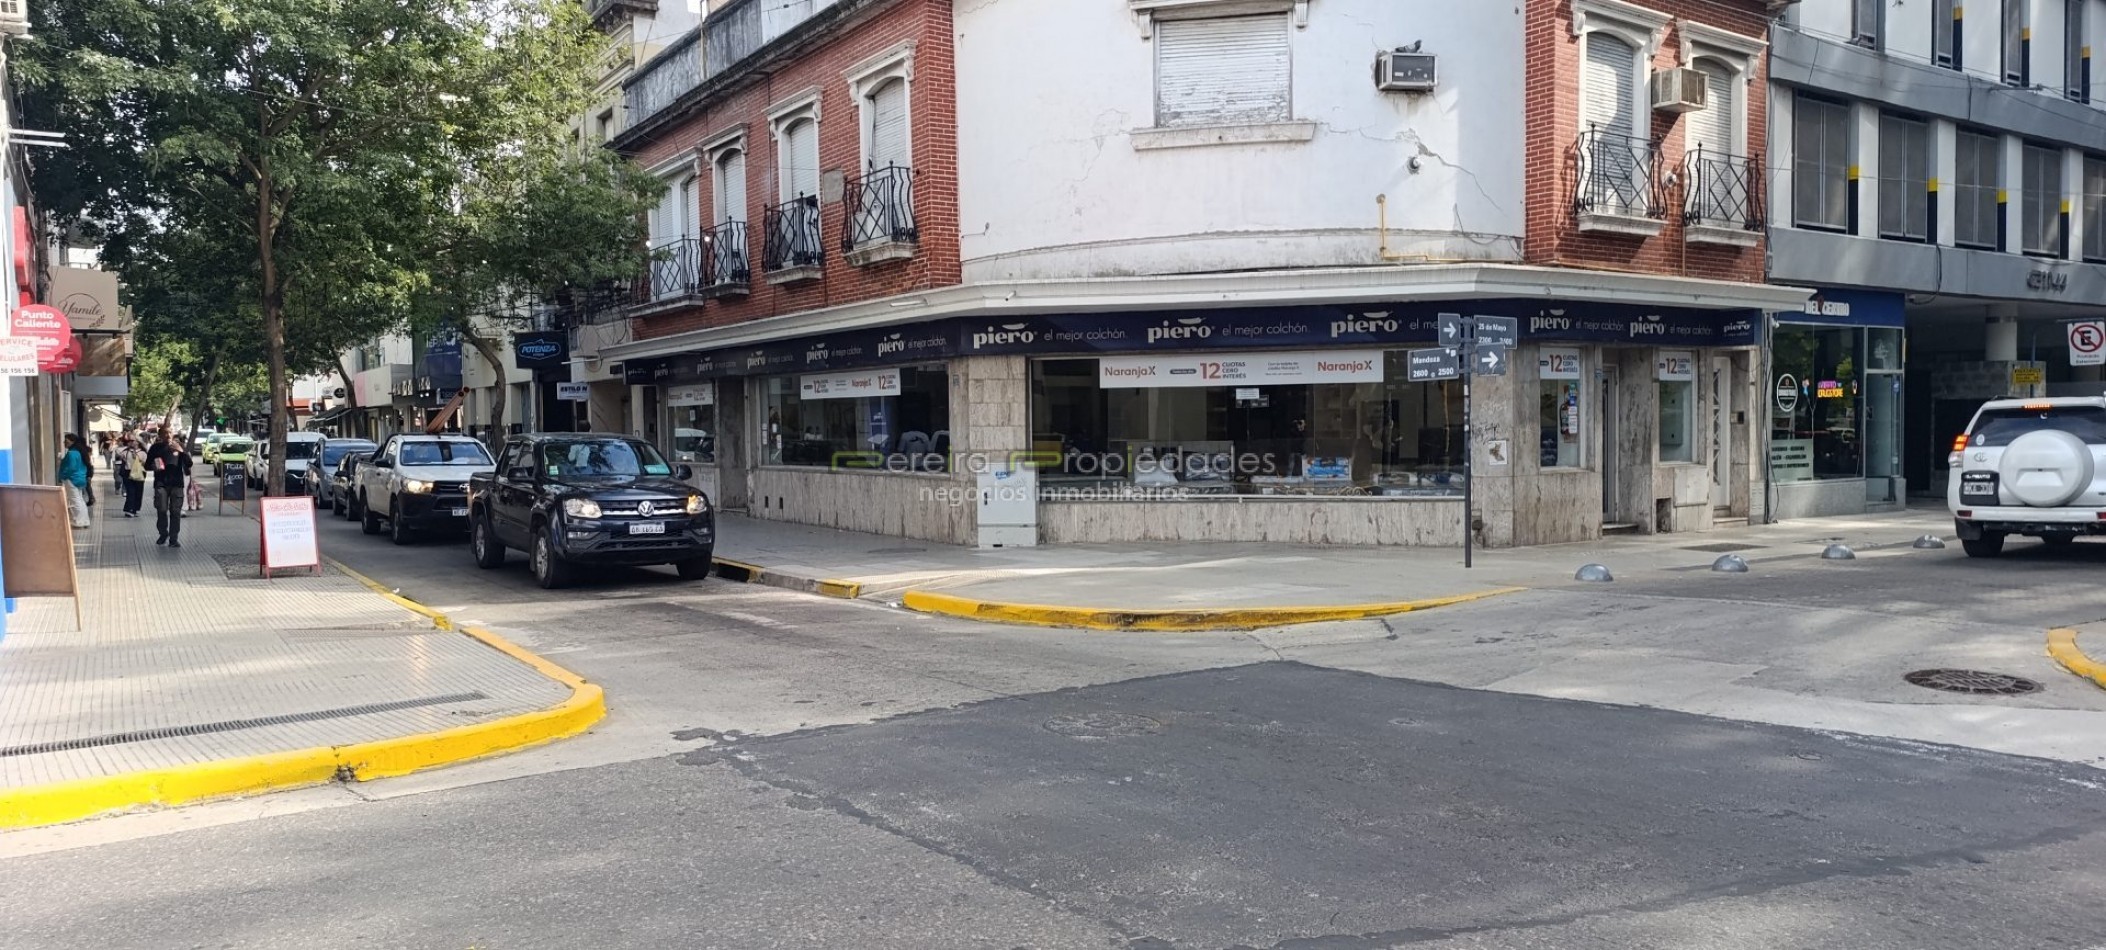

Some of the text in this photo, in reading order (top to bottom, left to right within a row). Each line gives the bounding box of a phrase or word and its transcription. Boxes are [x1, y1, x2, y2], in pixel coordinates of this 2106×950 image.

[22, 310, 54, 319] Punto
[1530, 310, 1570, 333] piero
[14, 319, 61, 328] Caliente
[1148, 320, 1212, 343] piero
[1222, 325, 1231, 336] el
[1331, 314, 1398, 338] piero
[1409, 318, 1419, 329] el
[1493, 323, 1507, 332] Mayo
[1630, 316, 1665, 338] piero
[1724, 322, 1750, 333] piero
[973, 326, 1034, 349] piero
[1044, 331, 1053, 341] el
[2081, 330, 2092, 346] E
[521, 345, 556, 354] POTENZA
[806, 345, 828, 364] piero
[878, 336, 904, 358] piero
[747, 353, 766, 370] piero
[1549, 354, 1562, 372] 12
[1666, 358, 1678, 374] 12
[1200, 362, 1222, 380] 12
[1412, 368, 1428, 378] 2600
[1438, 367, 1454, 376] 2500
[878, 375, 886, 390] 12
